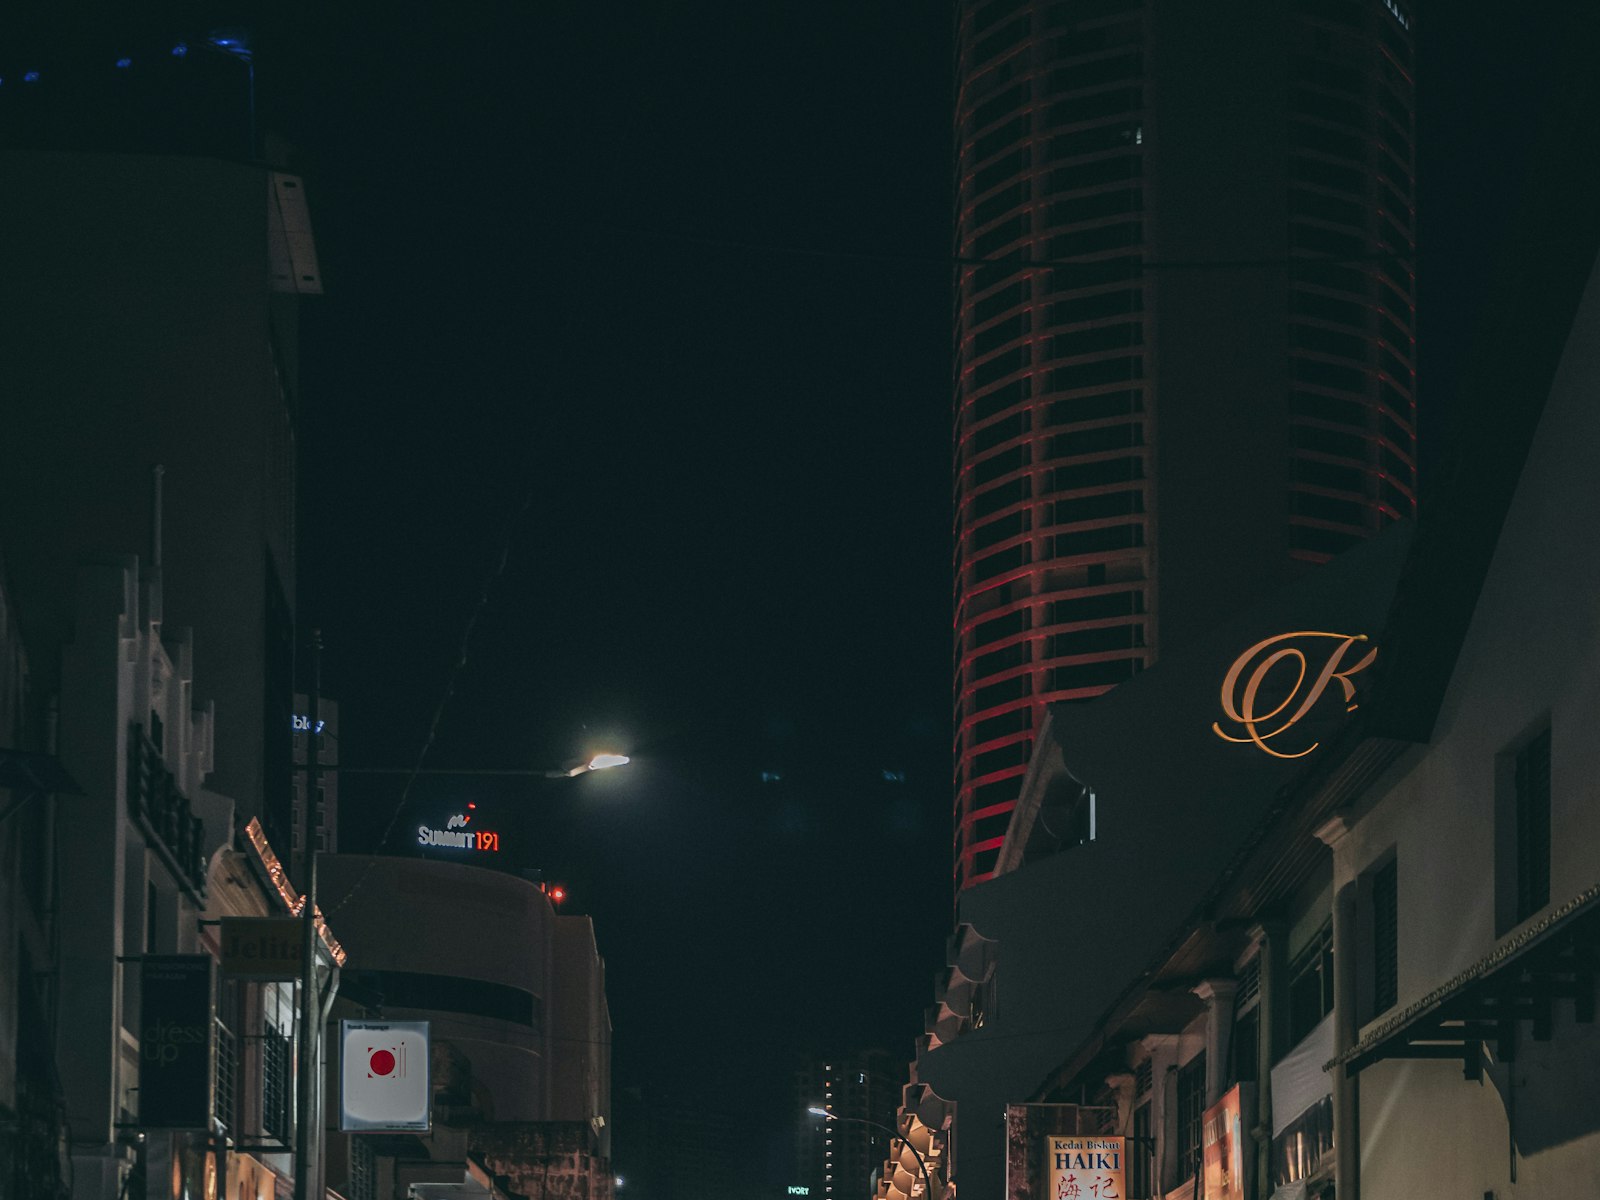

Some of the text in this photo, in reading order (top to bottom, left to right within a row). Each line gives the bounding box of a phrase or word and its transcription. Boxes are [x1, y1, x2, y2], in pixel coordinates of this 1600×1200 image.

[475, 831, 500, 851] 191
[144, 1017, 205, 1044] dress
[144, 1043, 179, 1067] up
[1054, 1140, 1120, 1150] Kedai Biskut
[1055, 1153, 1120, 1170] HAIKI
[788, 1185, 810, 1195] IVORY
